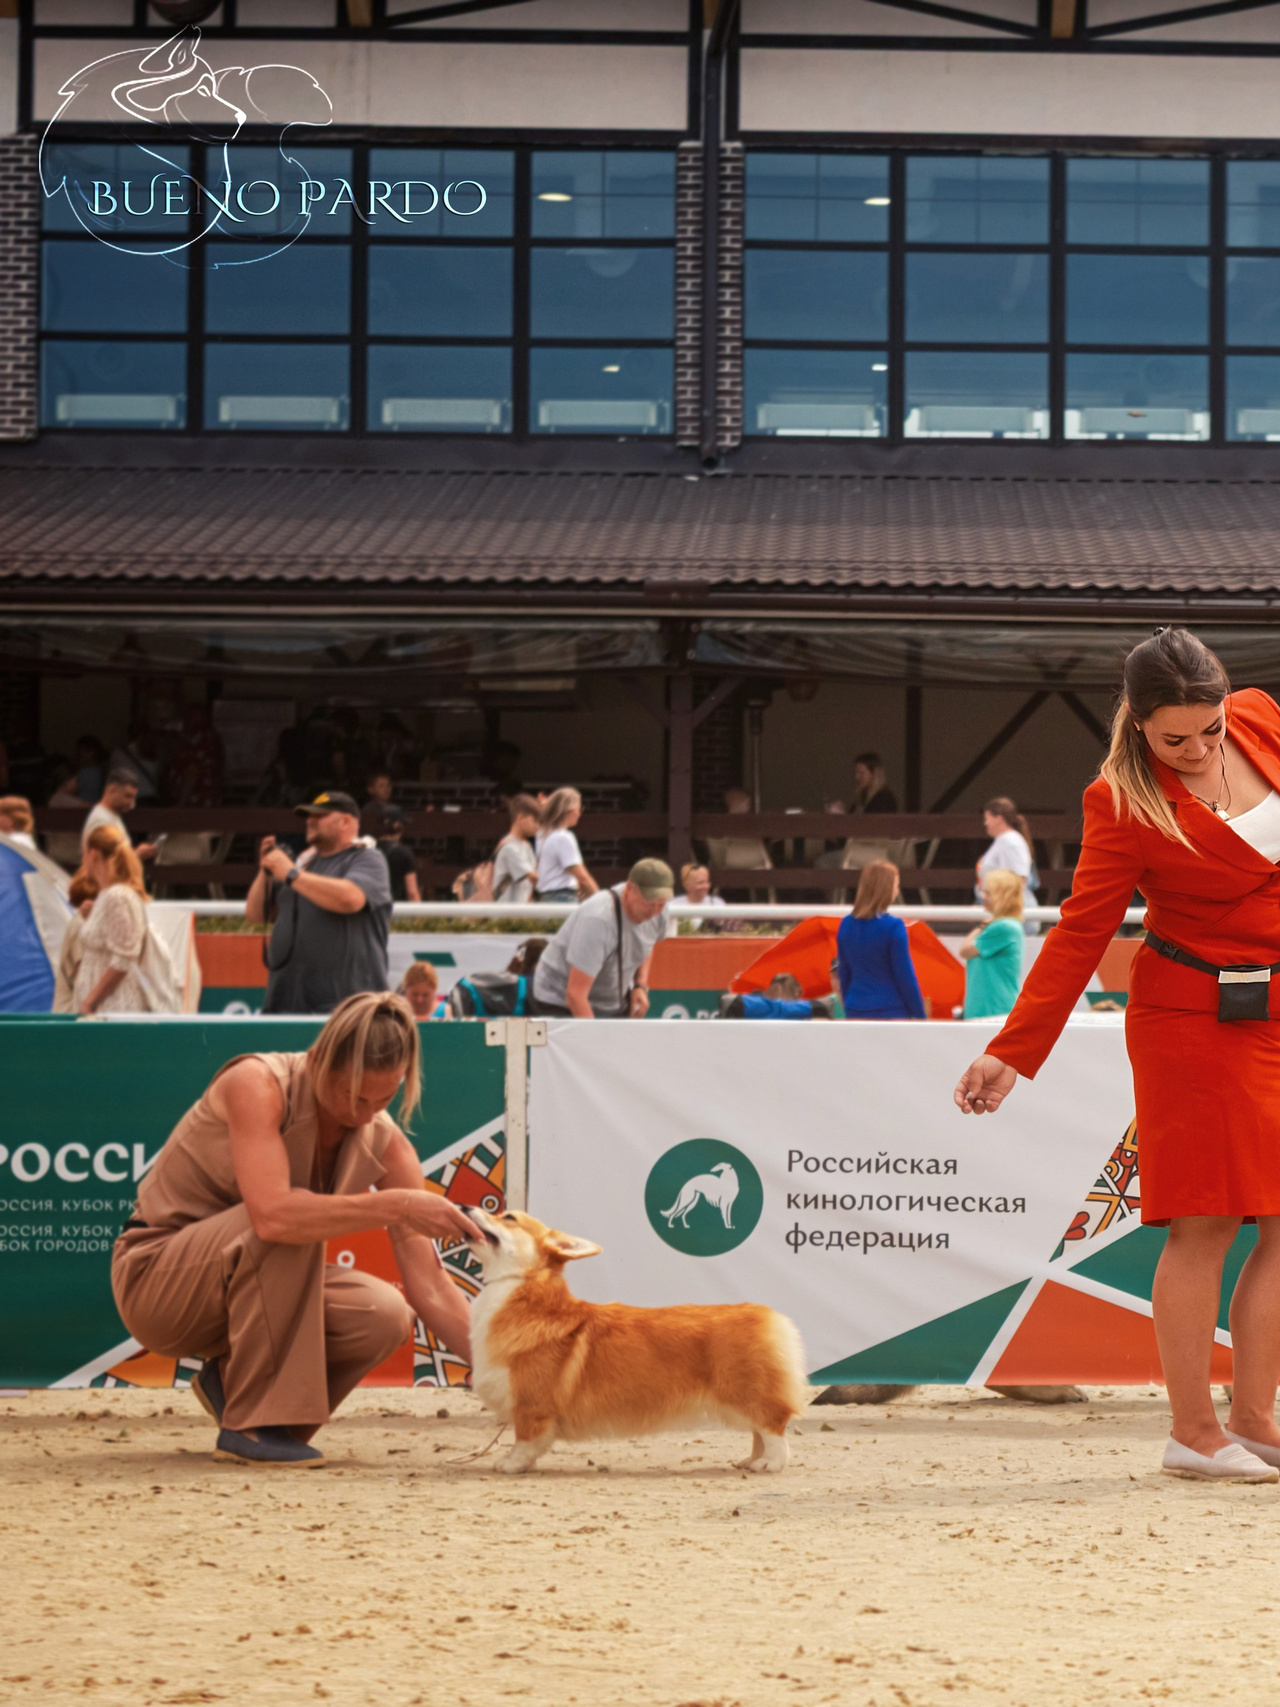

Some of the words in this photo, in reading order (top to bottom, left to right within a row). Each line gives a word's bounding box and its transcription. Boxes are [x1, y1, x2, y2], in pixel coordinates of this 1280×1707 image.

[0, 1142, 163, 1182] ОССИ
[787, 1149, 958, 1175] Российская
[0, 1199, 57, 1211] ОССИЯ.
[62, 1199, 113, 1211] КУБОК
[119, 1200, 137, 1212] РК
[786, 1193, 1026, 1213] кинологическая
[0, 1225, 57, 1237] ОССИЯ.
[62, 1225, 113, 1237] КУБОК
[785, 1222, 950, 1255] федерация
[0, 1240, 30, 1251] БОК
[36, 1240, 114, 1253] ГОРОДОВ-
